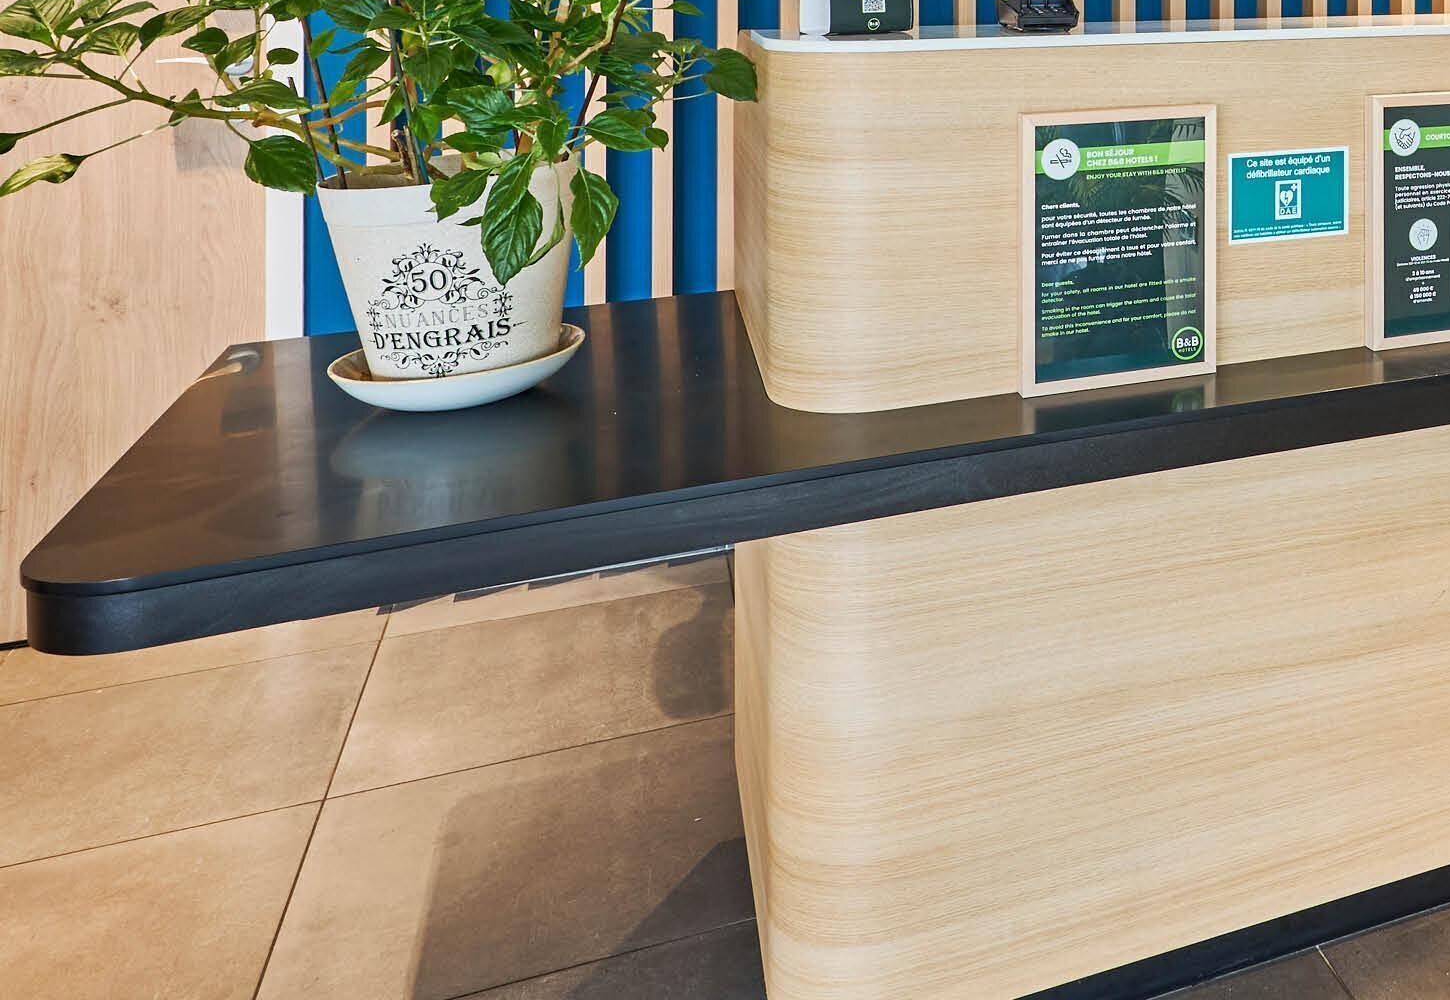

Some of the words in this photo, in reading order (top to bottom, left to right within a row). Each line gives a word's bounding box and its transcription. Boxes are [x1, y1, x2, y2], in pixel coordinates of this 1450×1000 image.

[1104, 149, 1134, 157] SÉJOUR
[1126, 156, 1154, 164] HOTELS
[1288, 156, 1313, 165] équipé
[1246, 170, 1292, 179] défibrillateur
[1294, 166, 1330, 176] cardiaque
[412, 269, 447, 292] 50
[386, 303, 489, 329] NUANCES
[374, 317, 511, 350] D'ENGRAIS
[1176, 336, 1199, 348] B&B
